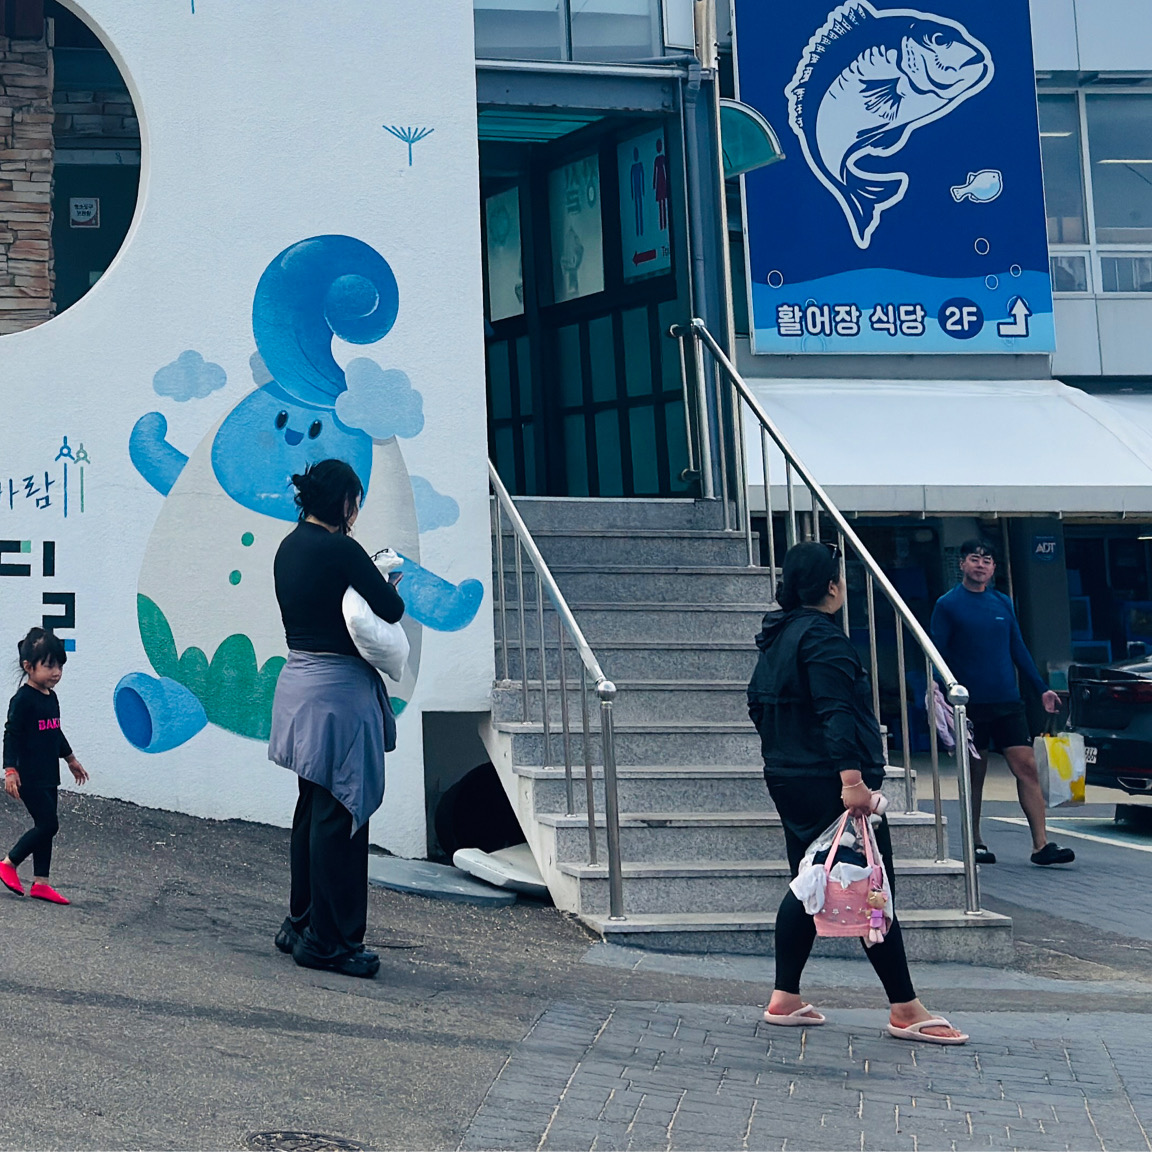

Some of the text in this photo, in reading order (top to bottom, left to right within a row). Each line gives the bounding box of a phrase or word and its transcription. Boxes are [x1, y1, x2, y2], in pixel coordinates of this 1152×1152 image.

[777, 304, 925, 335] 활어장 식당
[945, 306, 978, 331] 2F
[1035, 542, 1056, 553] ADT
